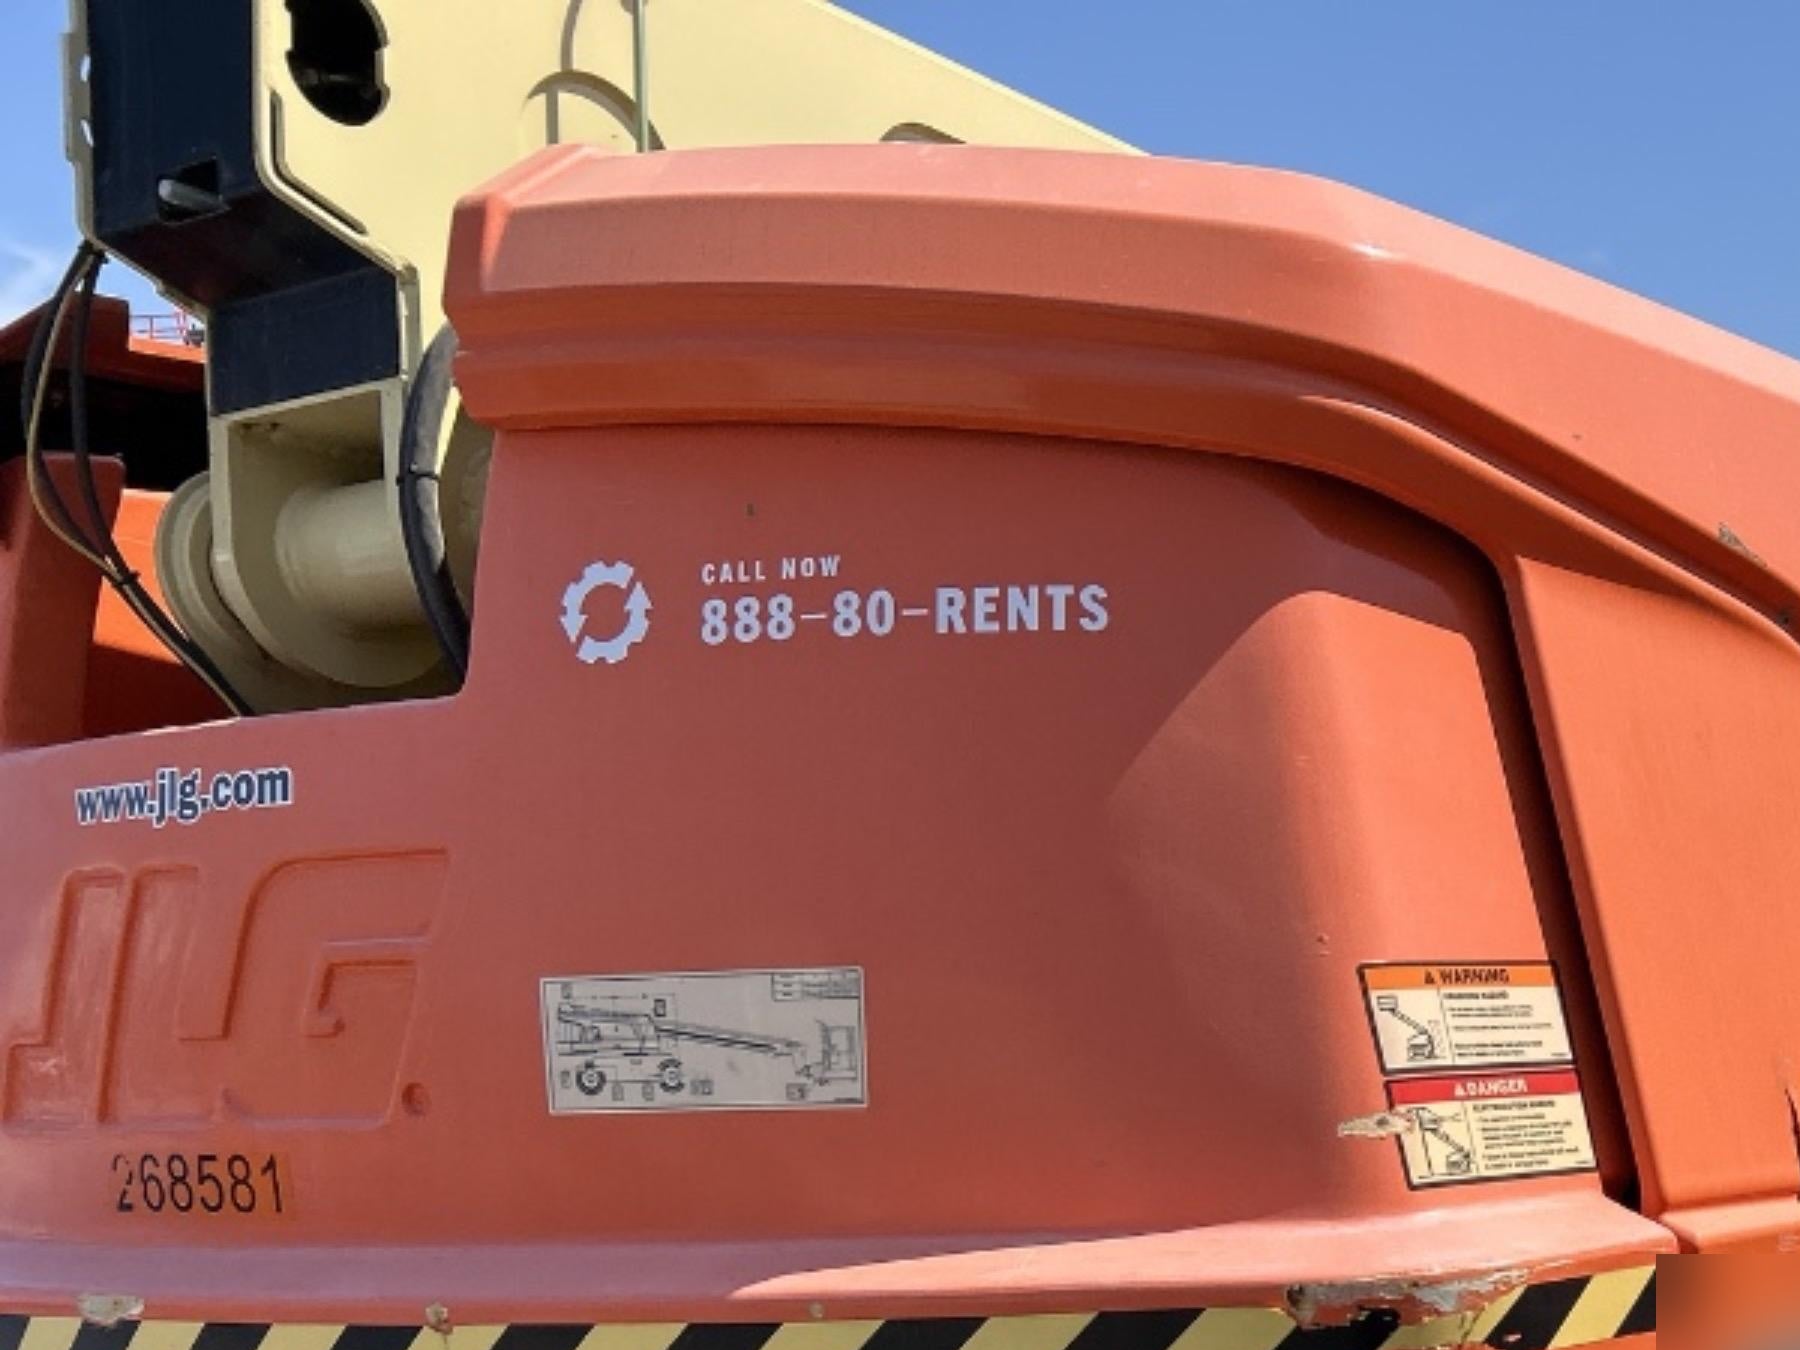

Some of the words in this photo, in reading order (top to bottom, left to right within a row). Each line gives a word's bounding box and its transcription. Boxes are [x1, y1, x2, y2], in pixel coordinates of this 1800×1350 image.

[702, 561, 767, 585] CALL
[781, 555, 841, 580] NOW
[701, 584, 1109, 646] 888-80-RENTS
[75, 767, 292, 828] www.jlg.com
[2, 848, 449, 1130] JLG
[112, 1154, 283, 1213] 268581
